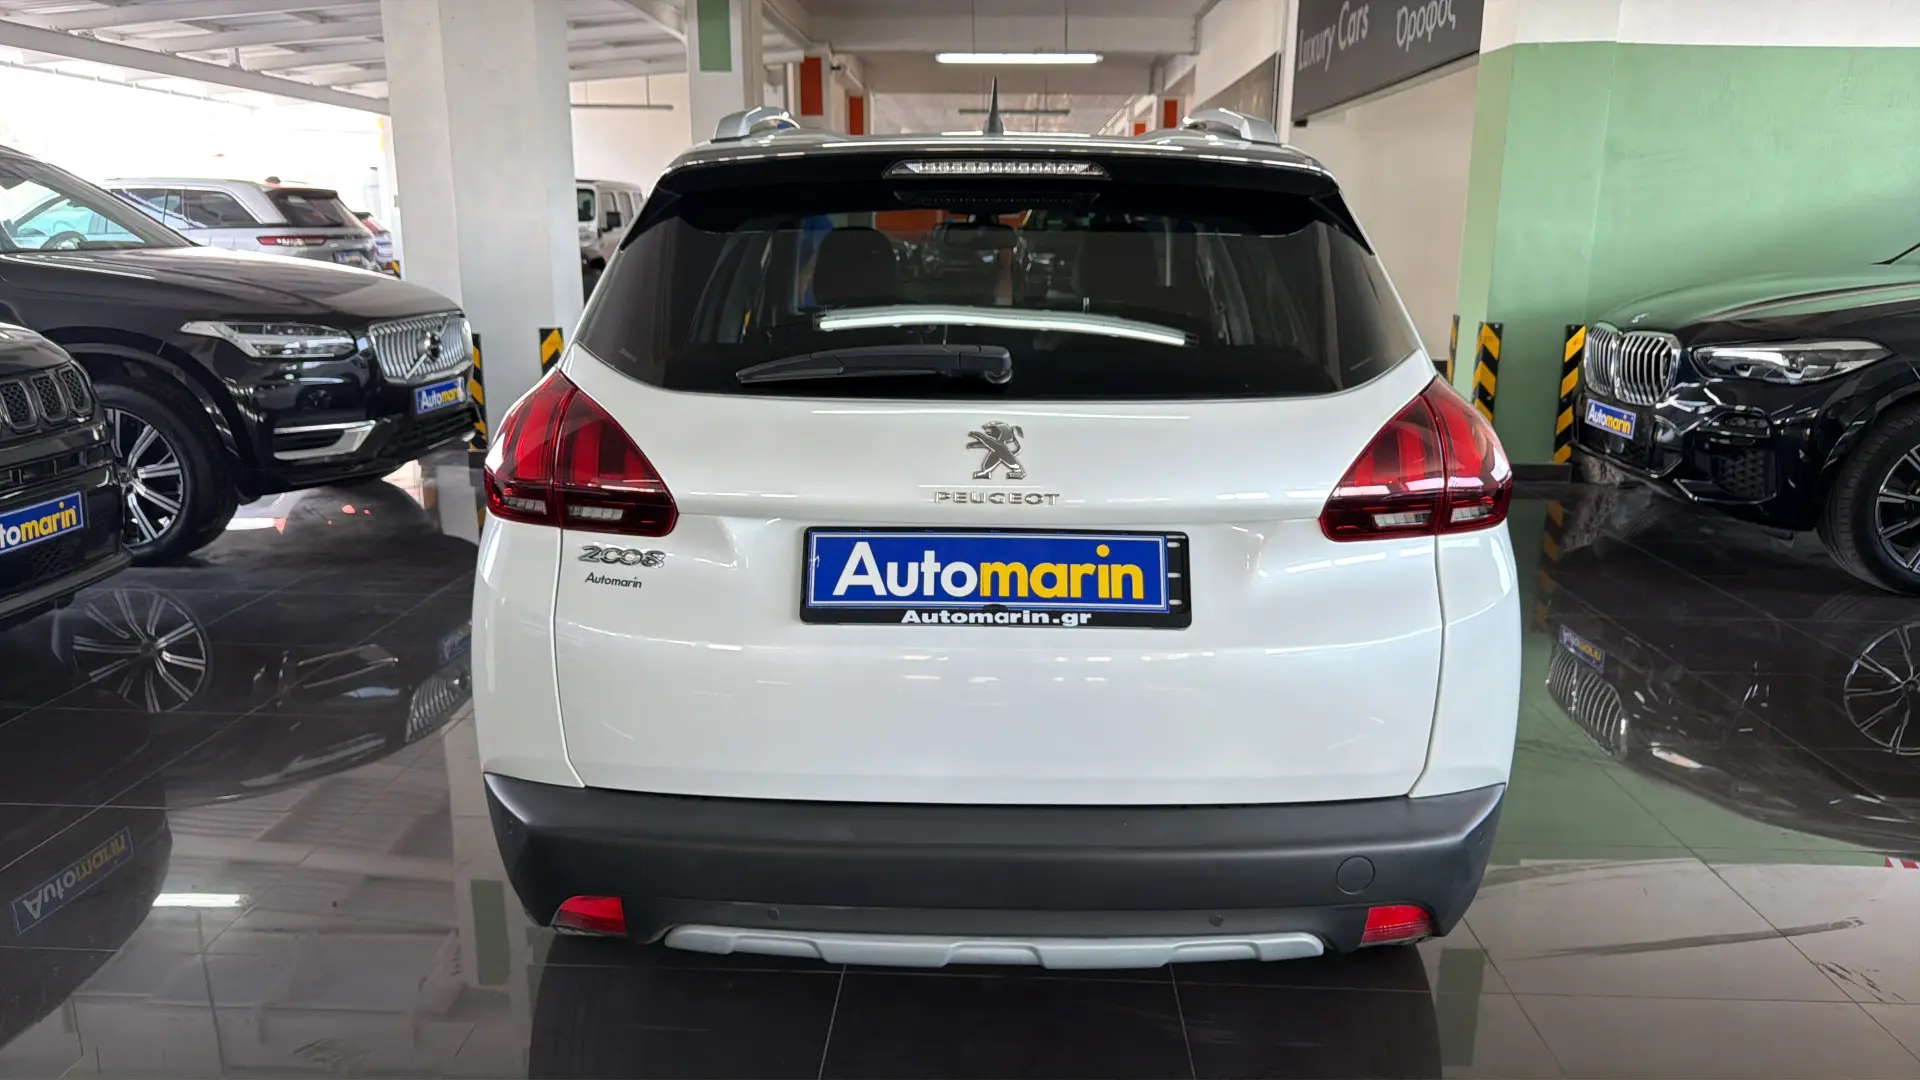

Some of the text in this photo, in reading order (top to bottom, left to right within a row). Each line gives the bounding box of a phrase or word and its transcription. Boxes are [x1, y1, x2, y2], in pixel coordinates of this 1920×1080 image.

[1298, 1, 1369, 72] Luxury Cars
[1587, 402, 1632, 436] Automarin
[934, 491, 1060, 506] PEUGEOT
[577, 545, 667, 569] 2008
[584, 571, 642, 589] Automarin
[832, 540, 1144, 600] Automarin
[901, 609, 1092, 627] Automarin.gr
